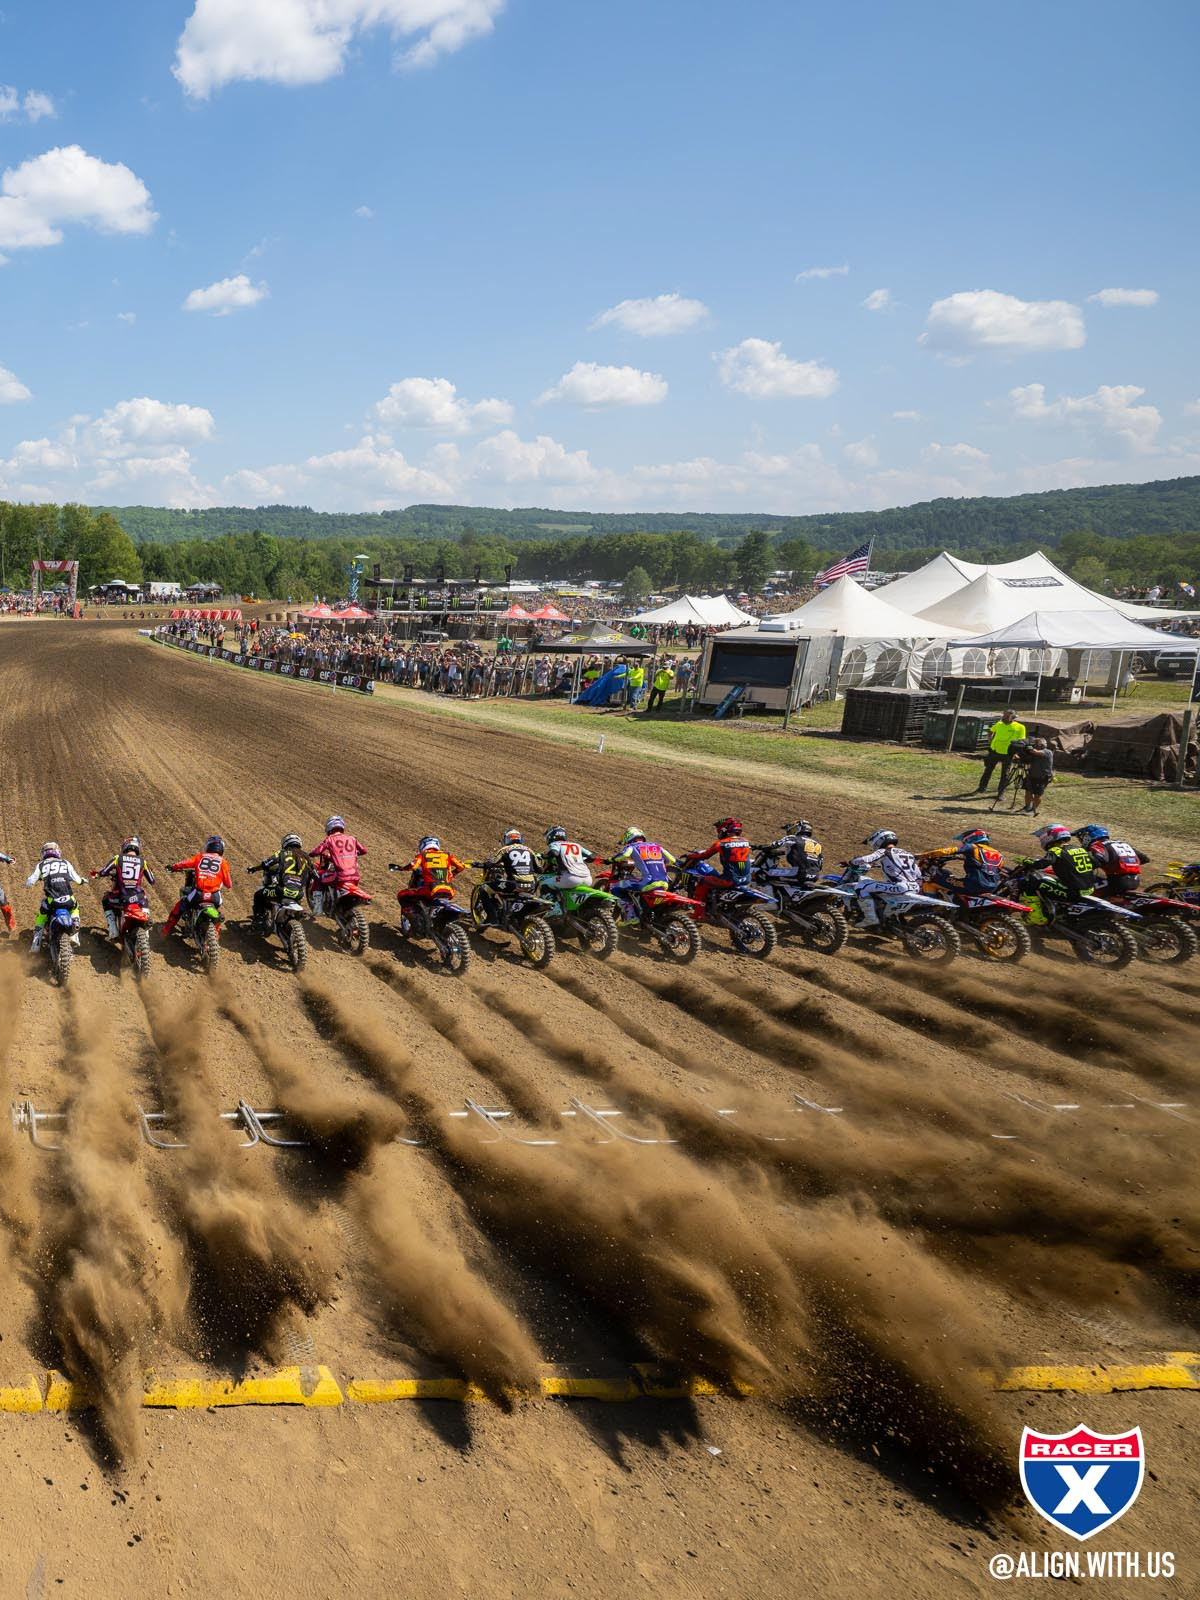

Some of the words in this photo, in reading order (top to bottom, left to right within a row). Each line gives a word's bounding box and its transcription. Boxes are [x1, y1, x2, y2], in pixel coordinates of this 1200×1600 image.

[248, 658, 256, 666] elf
[263, 660, 272, 669] elf
[280, 664, 290, 673] elf
[299, 667, 309, 676] elf
[319, 670, 330, 680] elf
[342, 674, 354, 685] elf
[560, 843, 580, 855] 70
[639, 845, 662, 860] 18
[1111, 842, 1137, 857] 69
[425, 853, 449, 869] 3
[508, 850, 531, 866] 94
[41, 862, 68, 878] 992
[121, 862, 141, 880] 51
[199, 857, 221, 873] 86
